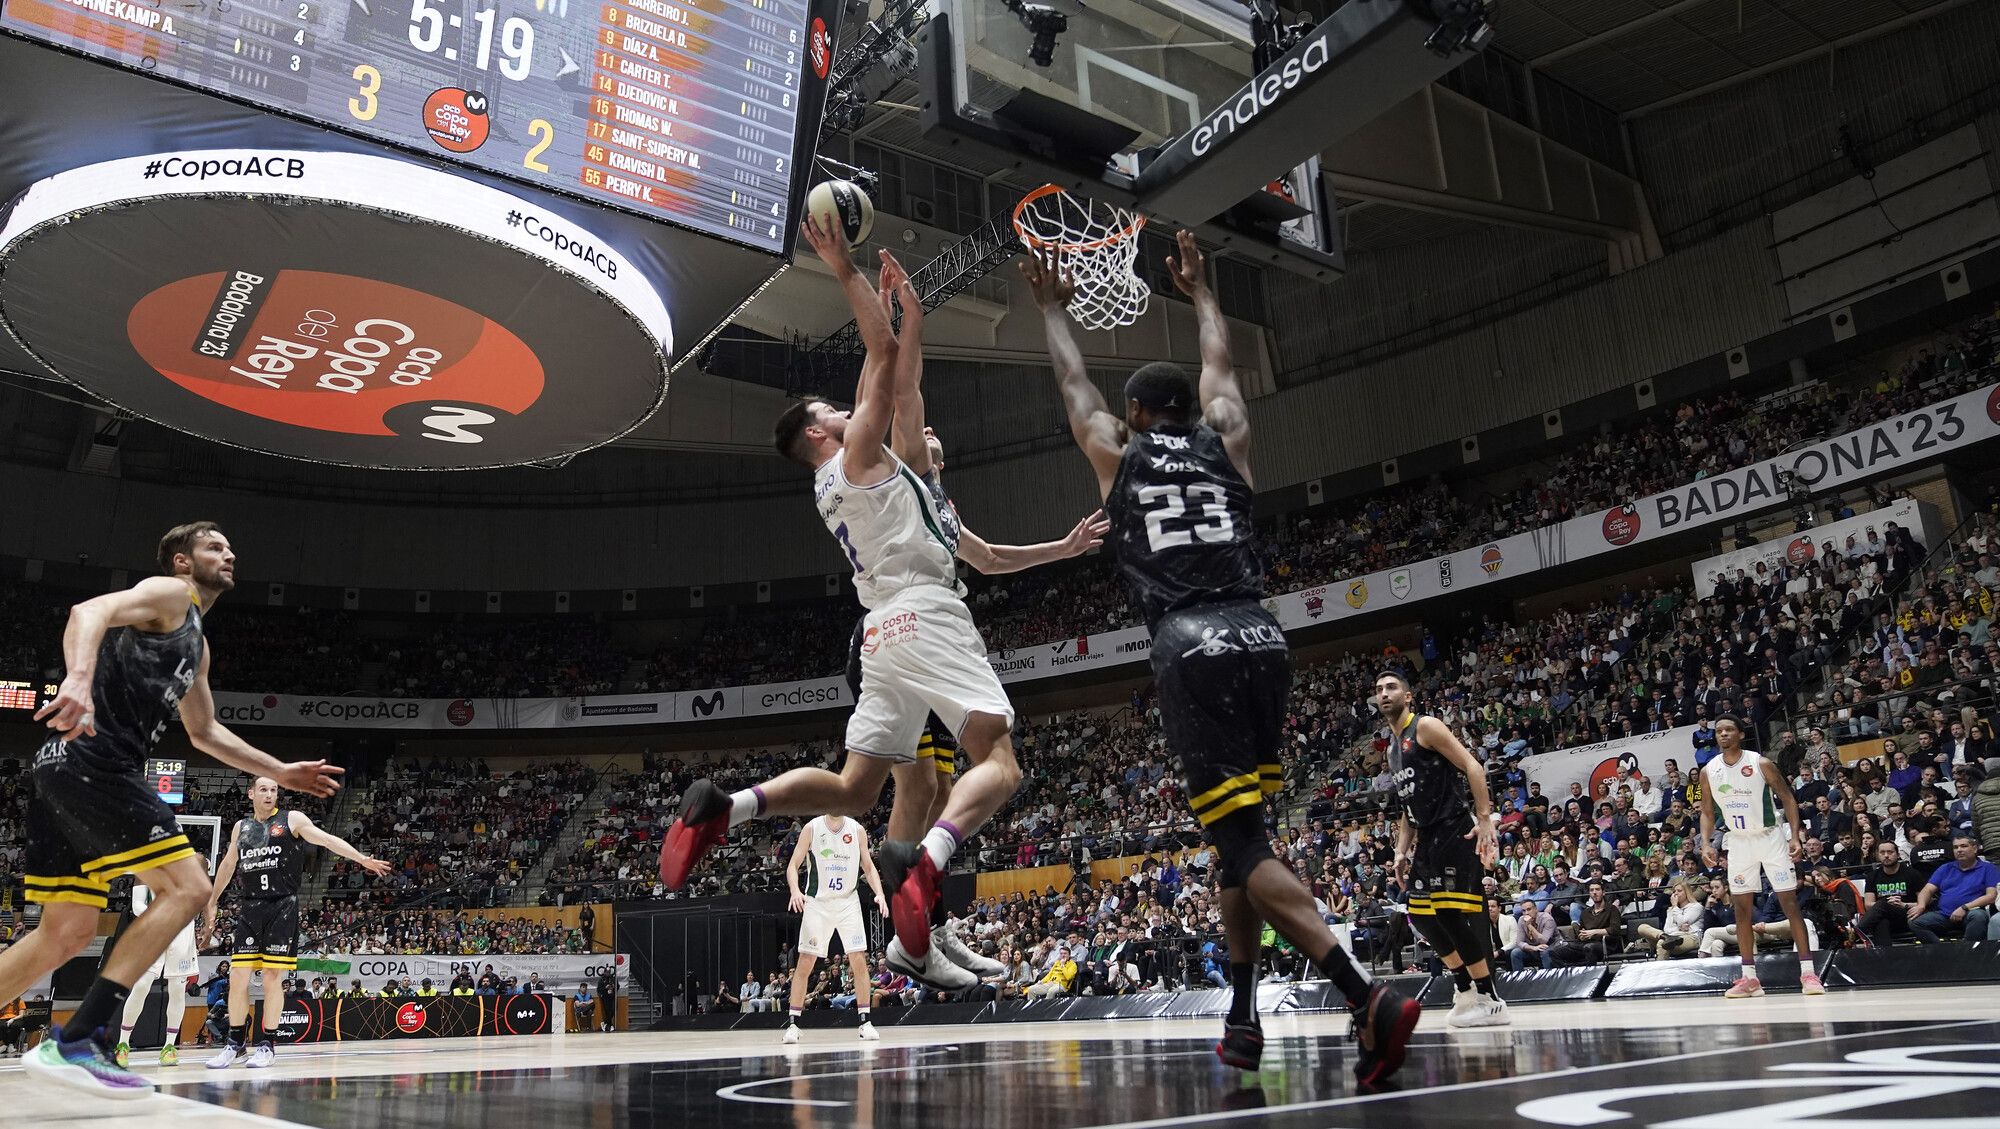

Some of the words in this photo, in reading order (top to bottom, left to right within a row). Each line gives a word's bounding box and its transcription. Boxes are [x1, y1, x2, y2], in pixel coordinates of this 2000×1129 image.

[65, 0, 160, 27] RNEKAMP
[161, 16, 177, 35] A.
[298, 3, 308, 19] 2
[681, 11, 689, 26] J.
[609, 8, 617, 21] 8
[626, 14, 675, 44] BRIZUELA
[677, 32, 687, 48] D.
[294, 30, 304, 46] 4
[408, 0, 535, 81] 5:19
[606, 30, 614, 44] 9
[623, 36, 647, 58] DÍAZ
[649, 46, 659, 62] A.
[290, 55, 300, 71] 3
[788, 51, 795, 64] 3
[602, 53, 614, 68] 11
[620, 60, 661, 86] CARTER
[663, 74, 671, 89] T.
[785, 73, 792, 86] 2
[348, 64, 381, 121] 3
[599, 76, 612, 92] 14
[617, 82, 666, 110] DJEDOVIC
[669, 99, 678, 115] N.
[1192, 34, 1329, 157] endesa
[435, 108, 469, 126] Copa
[443, 104, 460, 114] acb
[596, 99, 609, 115] 15
[615, 105, 659, 132] THOMAS
[661, 120, 673, 136] W.
[450, 123, 471, 139] Rey
[524, 119, 554, 173] 2
[593, 123, 606, 138] 17
[612, 128, 687, 164] SAINT-SUPERY
[689, 153, 701, 169] M.
[144, 156, 305, 181] #CopaACB
[588, 146, 603, 161] 45
[609, 152, 655, 178] KRAVISH
[657, 166, 667, 182] D.
[776, 158, 783, 172] 2
[586, 169, 600, 185] 55
[605, 175, 641, 198] PERRY
[642, 187, 653, 202] K.
[771, 203, 779, 216] 4
[769, 225, 777, 238] 4
[506, 209, 617, 281] #CopaACB
[214, 270, 264, 343] Badalona
[294, 308, 339, 343] del
[199, 339, 230, 358] '23
[316, 318, 414, 395] Copa
[229, 335, 317, 389] Rey
[388, 347, 443, 386] acb
[1656, 402, 1965, 529] BADALONA'23
[1138, 482, 1234, 552] 23
[1609, 522, 1628, 531] Copa
[1619, 527, 1631, 535] Rey
[834, 521, 864, 573] 7
[1300, 587, 1326, 598] CAZOO
[883, 612, 917, 629] COSTA
[883, 629, 897, 640] DEL
[899, 624, 918, 634] SOL
[992, 656, 1035, 673] PALDING
[1087, 652, 1104, 661] viajes
[44, 684, 58, 696] 30
[761, 685, 839, 707] endesa
[219, 703, 266, 721] acb
[299, 700, 419, 720] #CopaACB
[1570, 743, 1607, 754] COPA
[1641, 729, 1672, 741] REY
[156, 761, 182, 773] 5:19
[158, 776, 172, 793] 6
[1602, 775, 1618, 784] acb
[240, 846, 282, 860] Lenovo
[261, 874, 268, 890] 9
[829, 877, 843, 891] 45
[359, 961, 409, 976] COPA
[413, 961, 445, 976] DEL
[279, 1015, 309, 1024] DALORIAN
